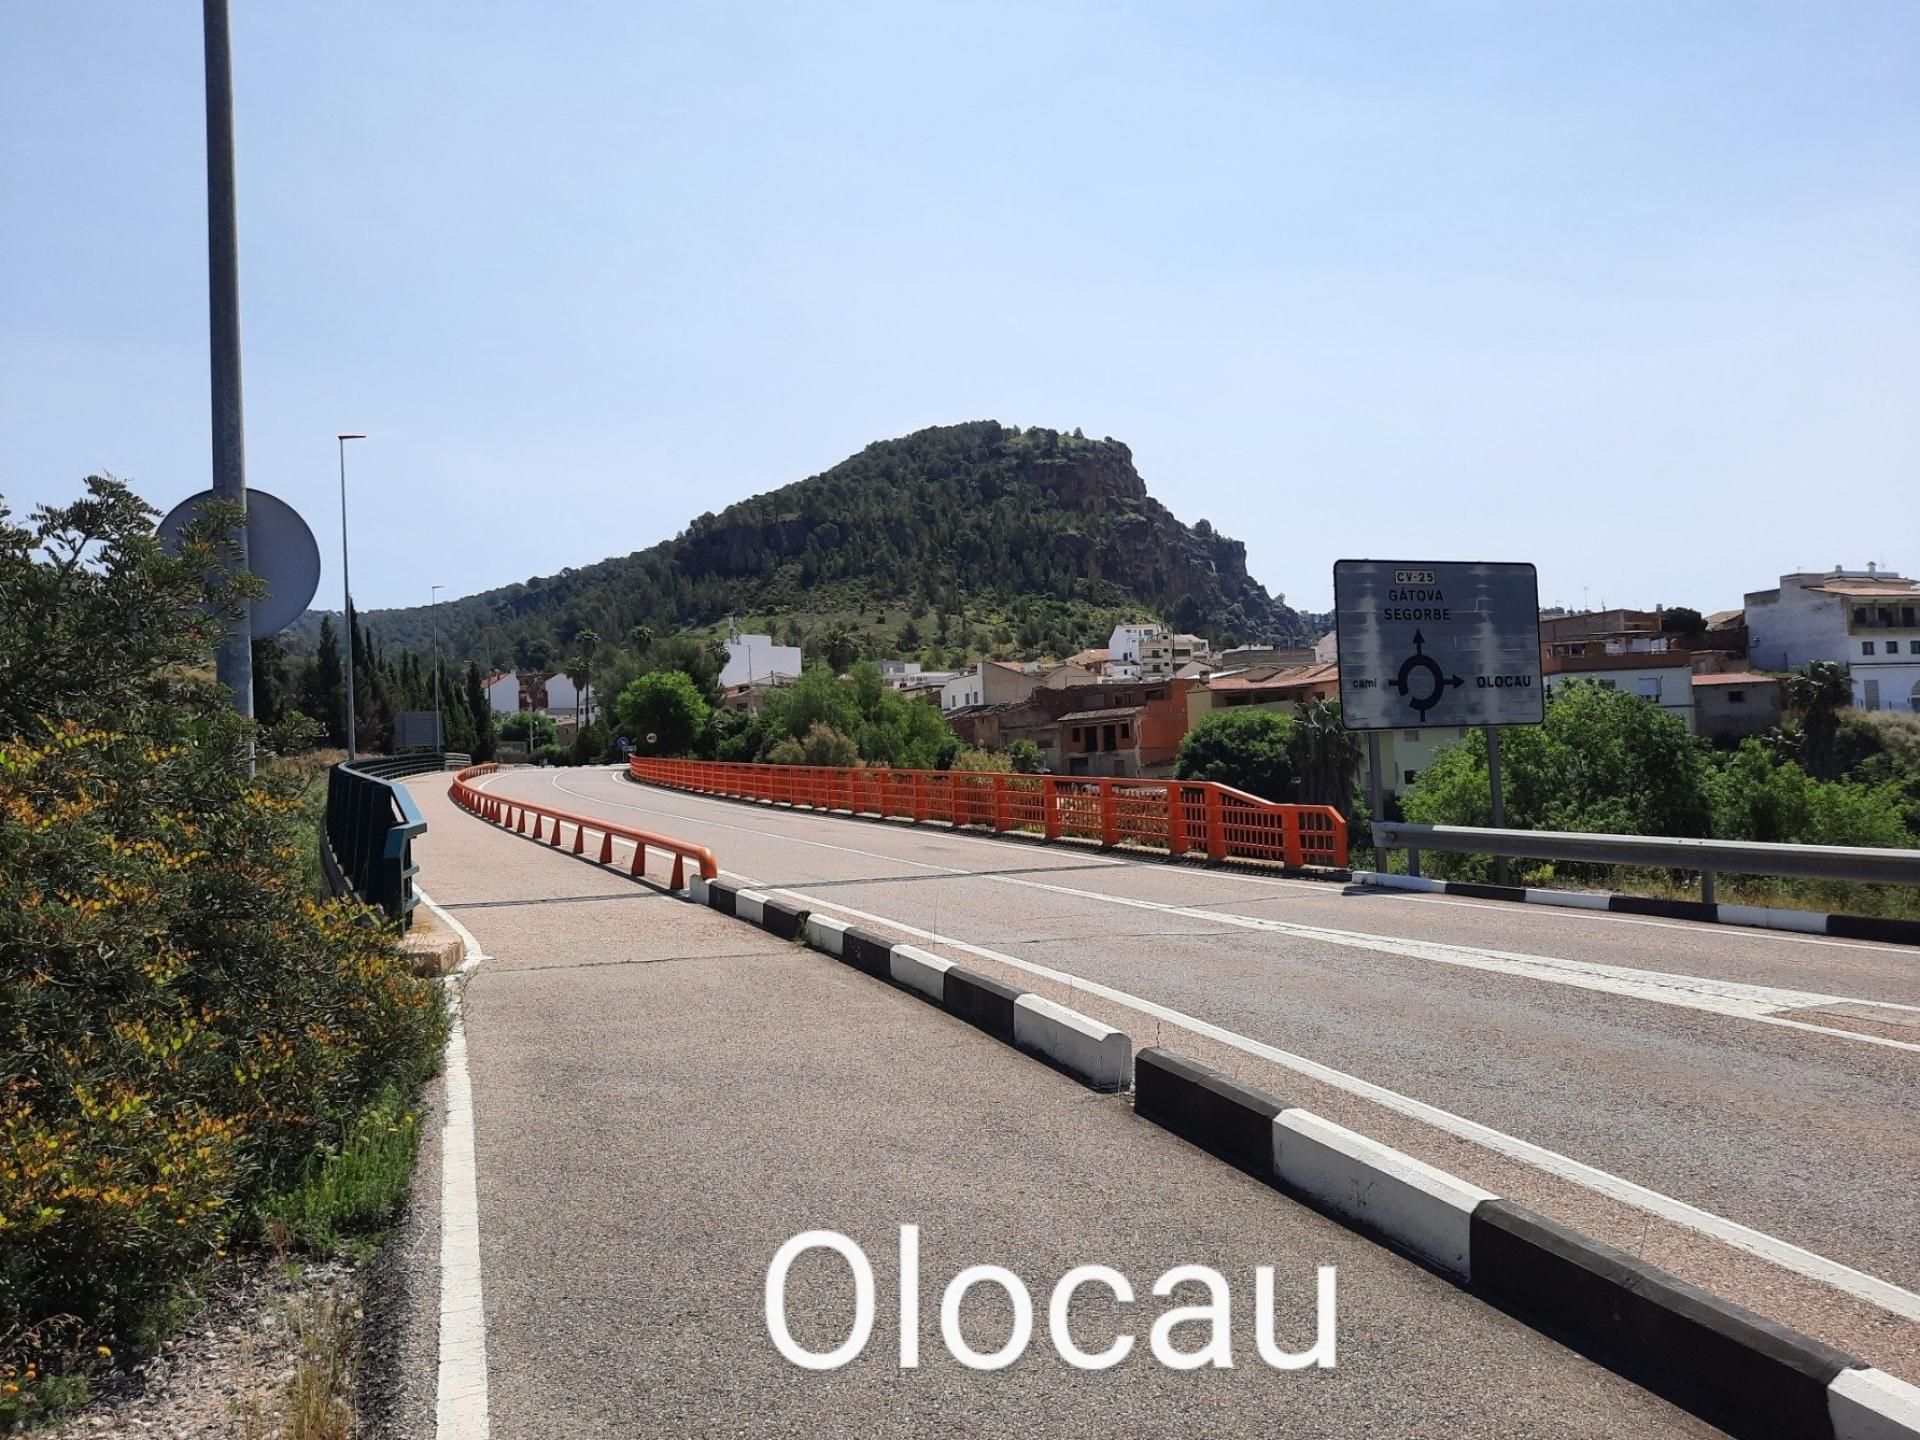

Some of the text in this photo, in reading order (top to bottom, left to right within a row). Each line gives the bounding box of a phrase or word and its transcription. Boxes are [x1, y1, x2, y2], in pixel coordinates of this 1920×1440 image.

[1397, 572, 1433, 582] CV-25
[1384, 608, 1451, 621] SEGORBE
[1477, 675, 1531, 688] OLOCAU
